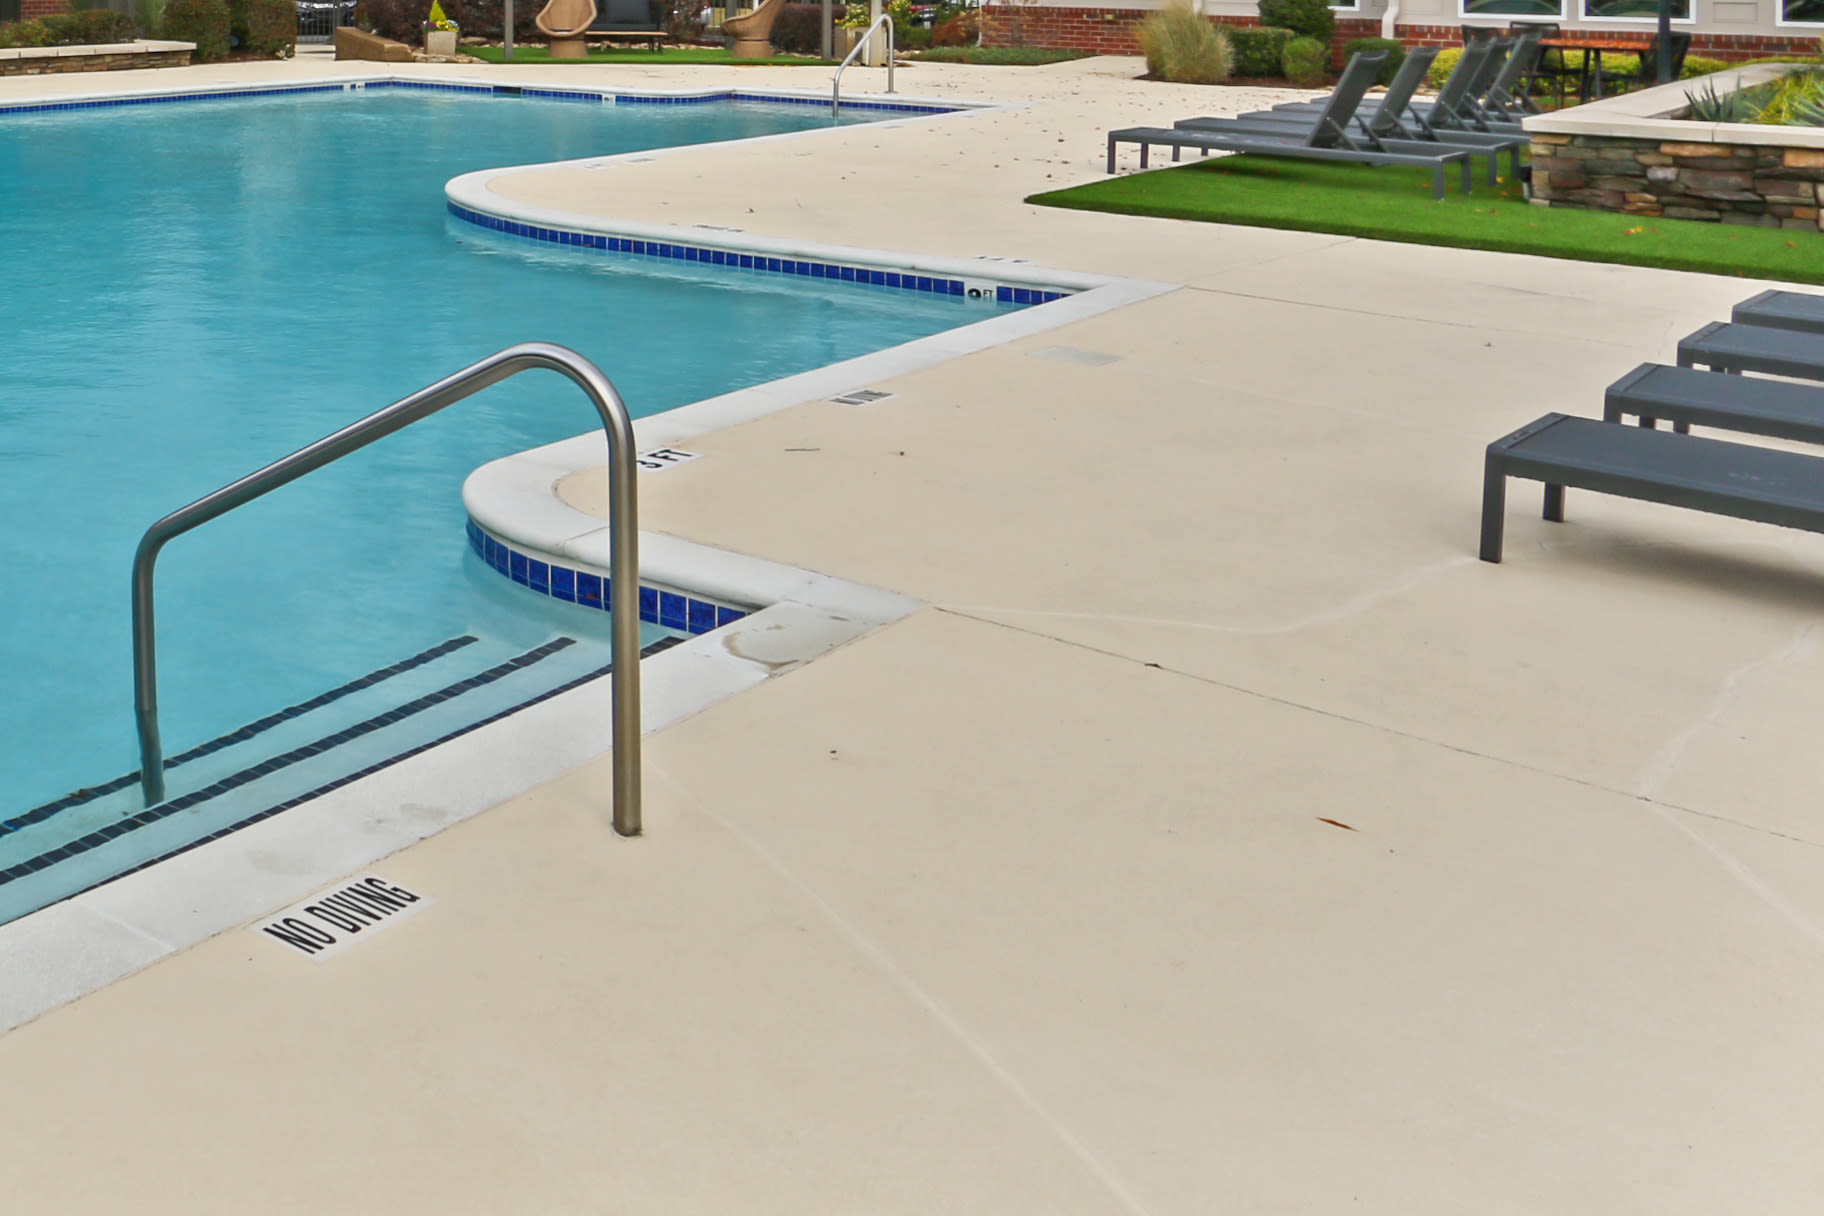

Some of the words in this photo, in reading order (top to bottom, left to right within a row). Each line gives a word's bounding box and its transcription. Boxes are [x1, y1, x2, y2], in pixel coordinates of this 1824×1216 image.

[647, 448, 693, 462] FT
[262, 917, 337, 955] NO
[303, 877, 421, 934] DIVING
